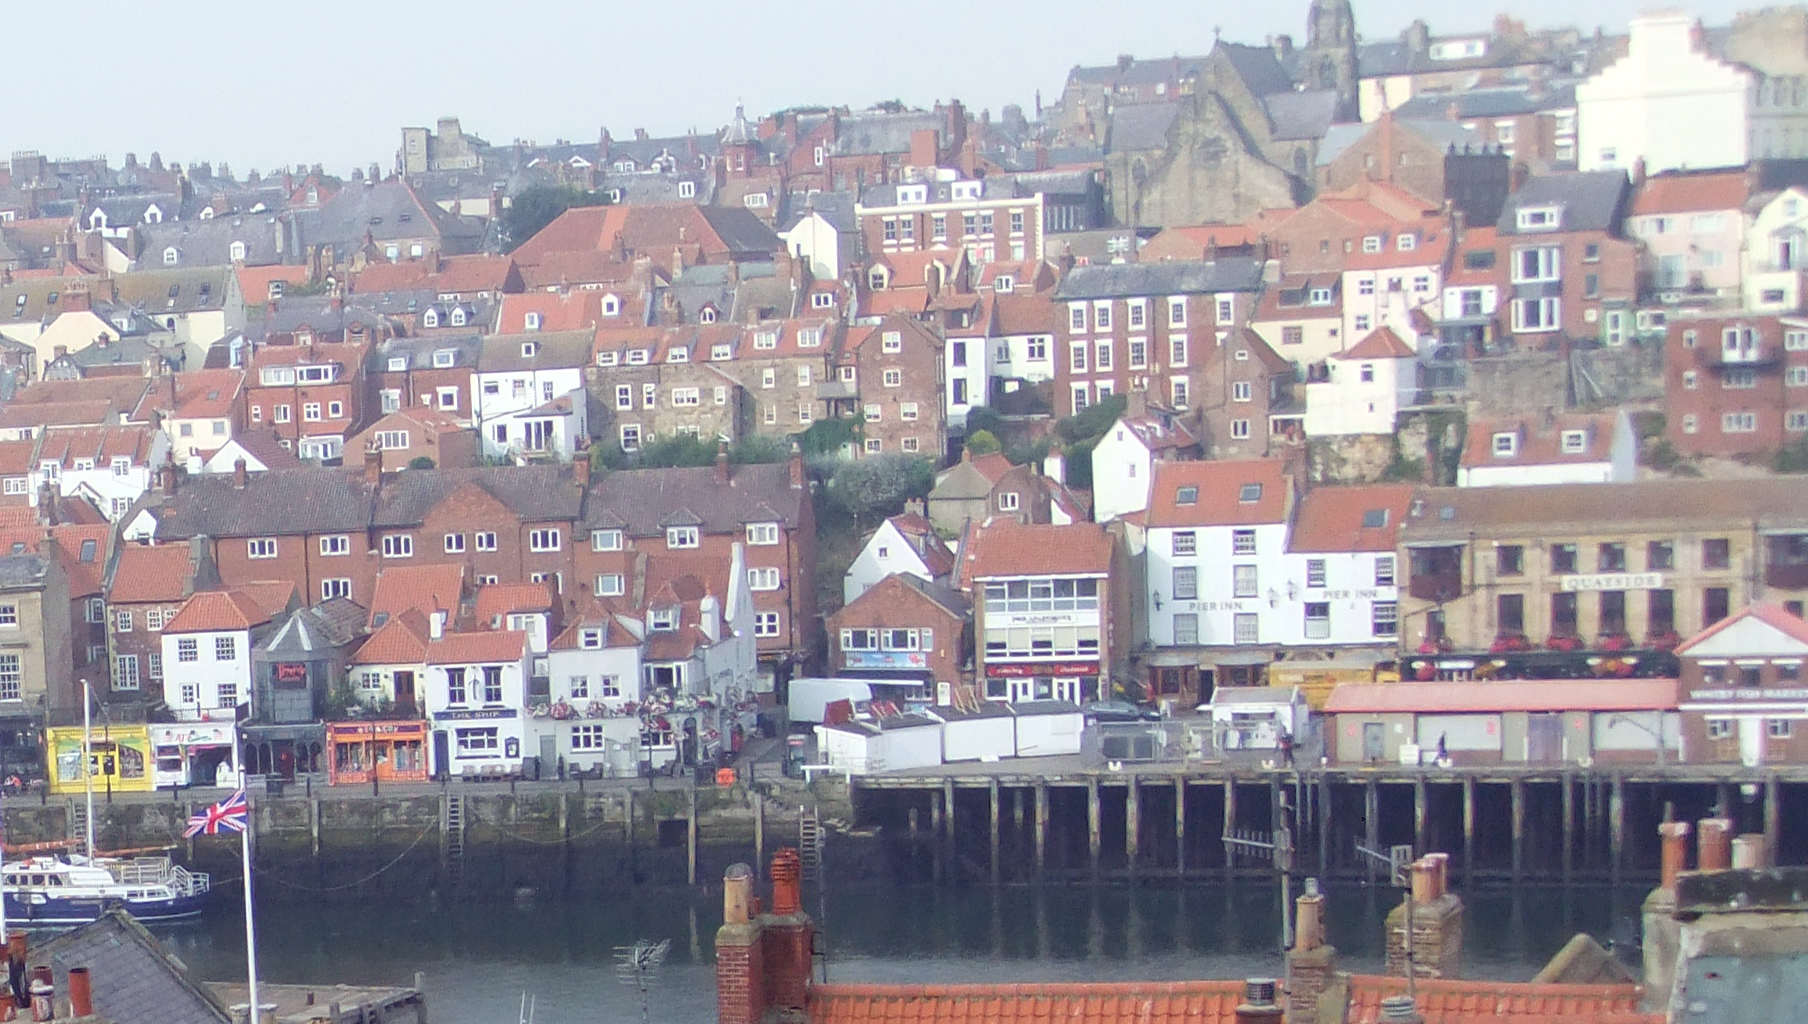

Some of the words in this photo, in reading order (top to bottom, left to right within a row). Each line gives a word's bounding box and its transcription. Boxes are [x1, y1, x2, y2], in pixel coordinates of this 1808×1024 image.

[1568, 576, 1657, 590] QUAYSIDE
[1323, 590, 1350, 600] PIER
[1354, 589, 1378, 599] INN
[1189, 601, 1217, 611] PIER
[1220, 601, 1243, 611] INN
